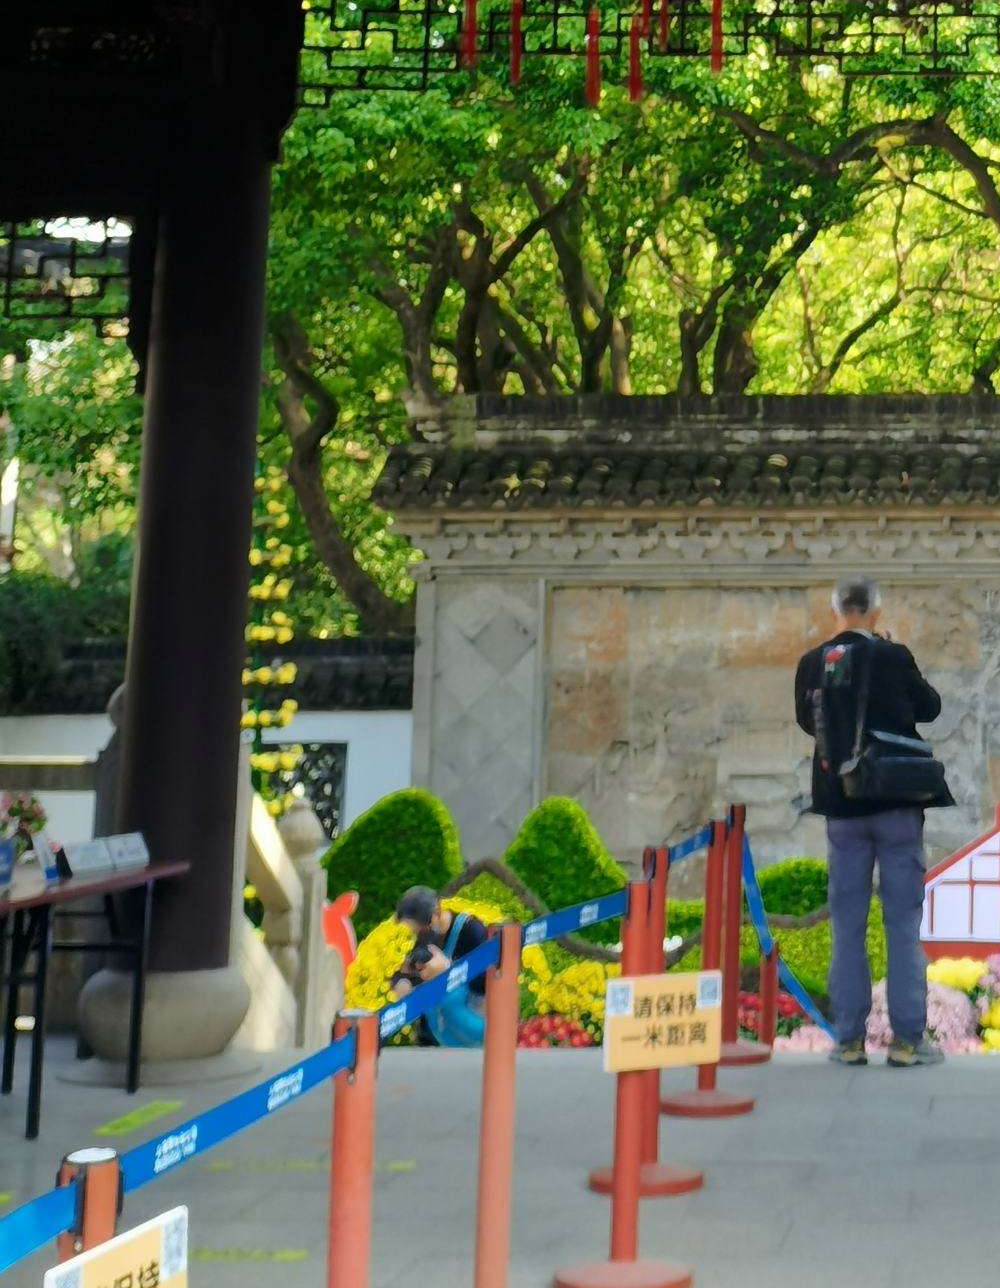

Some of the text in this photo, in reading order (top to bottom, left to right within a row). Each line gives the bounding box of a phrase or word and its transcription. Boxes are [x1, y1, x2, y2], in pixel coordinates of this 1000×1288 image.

[633, 992, 697, 1020] 请保持
[620, 1021, 707, 1050] 一米距离
